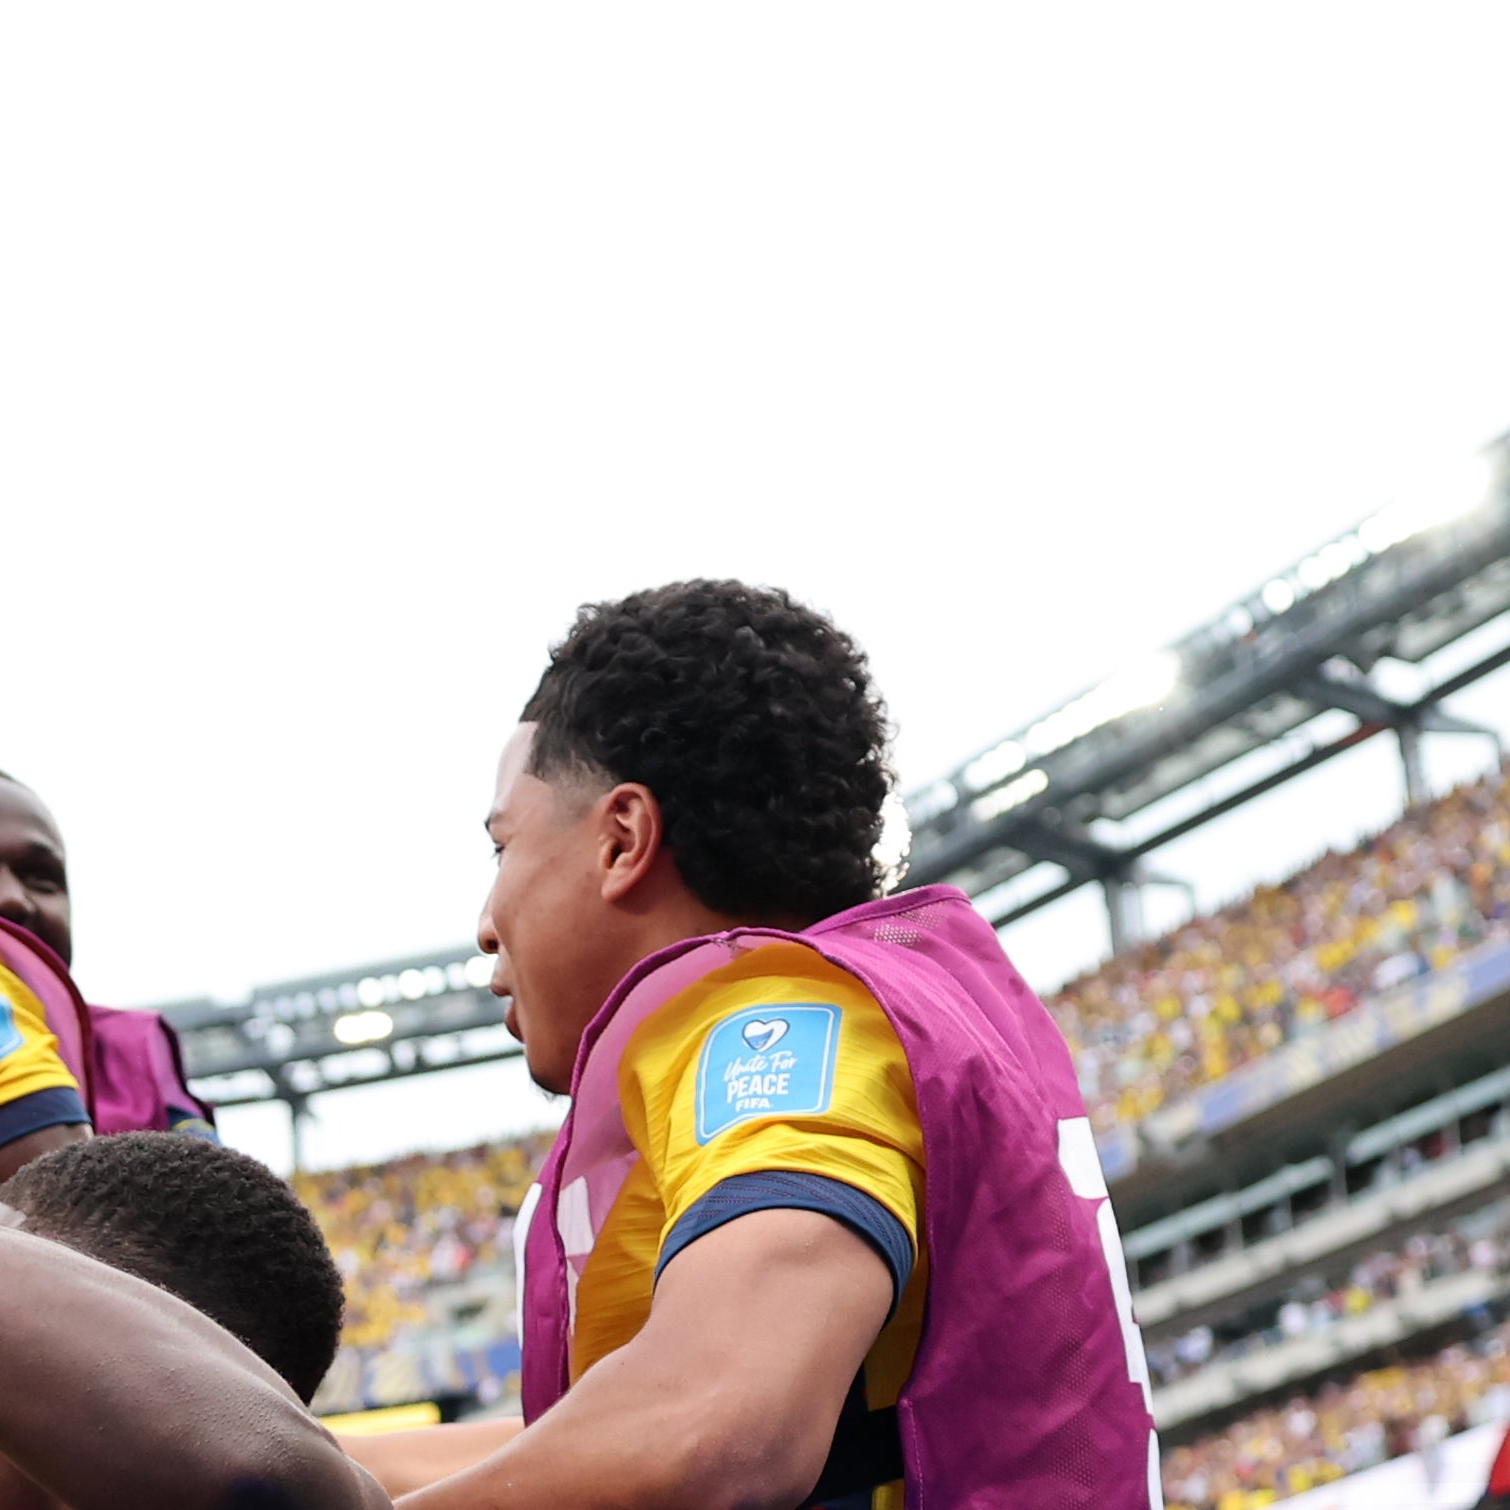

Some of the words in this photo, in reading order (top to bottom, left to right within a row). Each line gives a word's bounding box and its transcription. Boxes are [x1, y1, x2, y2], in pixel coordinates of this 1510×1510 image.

[769, 1050, 798, 1073] For
[726, 1073, 791, 1104] PEACE
[735, 1097, 771, 1112] FIFA
